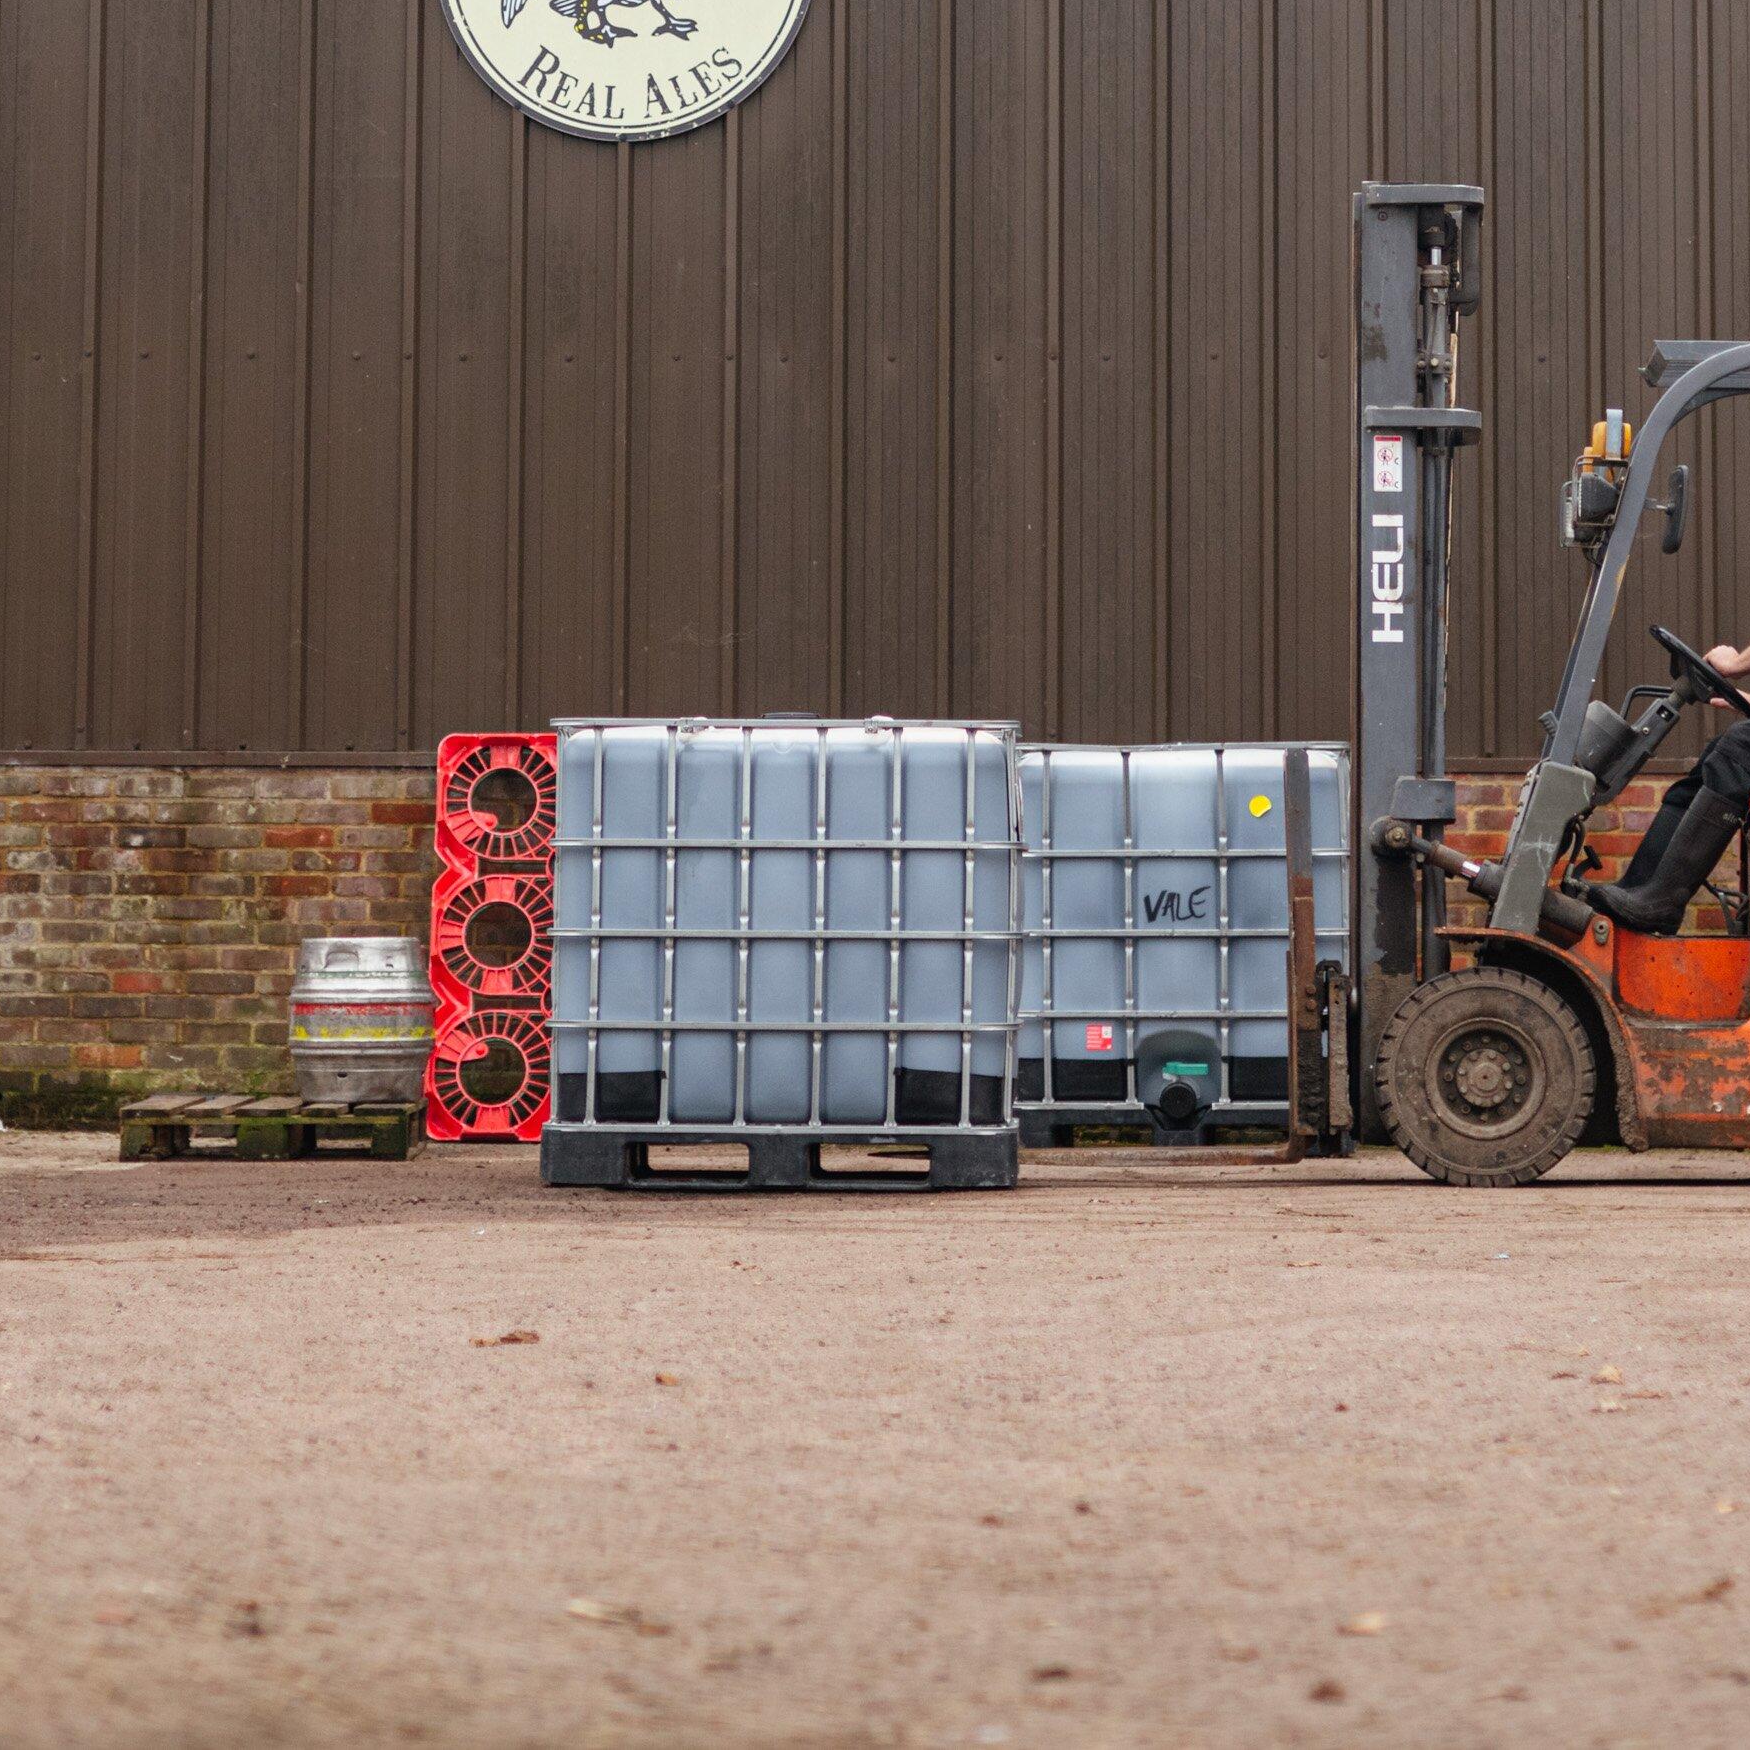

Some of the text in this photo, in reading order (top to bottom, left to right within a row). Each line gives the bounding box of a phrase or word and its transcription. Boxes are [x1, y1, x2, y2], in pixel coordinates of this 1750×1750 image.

[516, 44, 744, 119] REAL ALES
[1372, 514, 1404, 643] HELI
[1143, 885, 1212, 924] VALE
